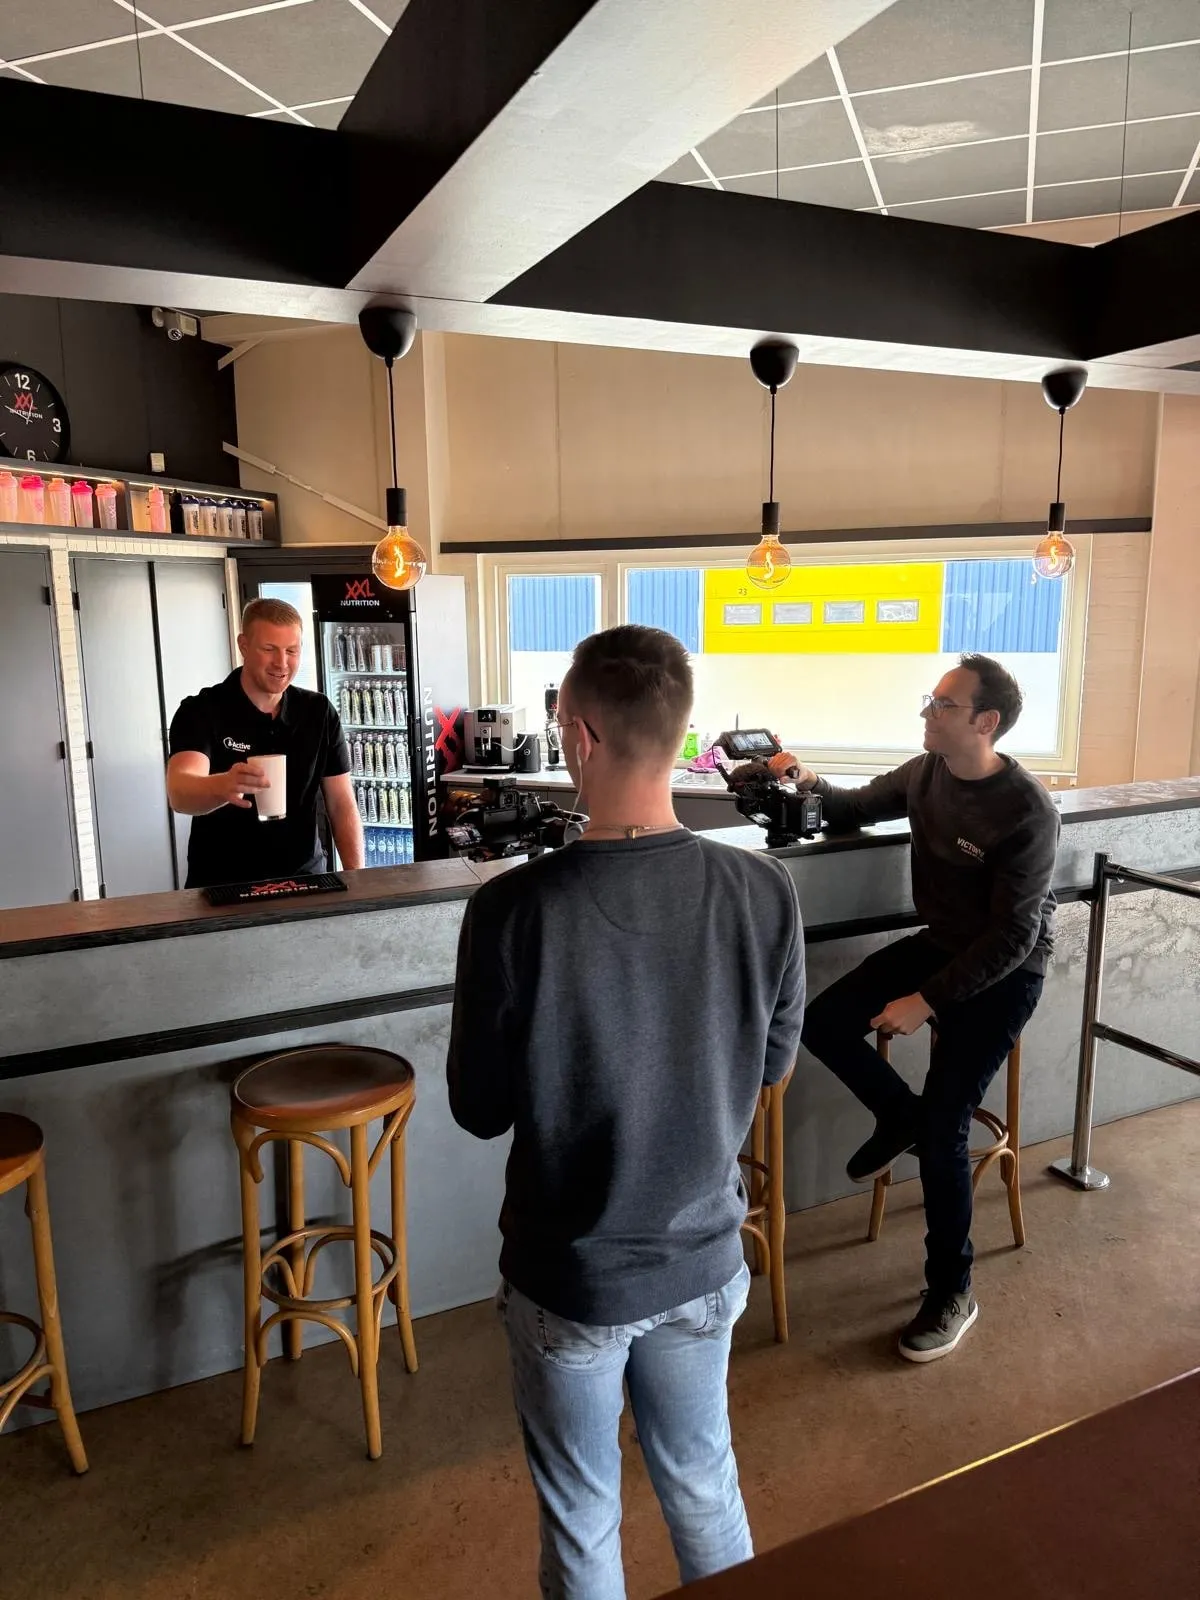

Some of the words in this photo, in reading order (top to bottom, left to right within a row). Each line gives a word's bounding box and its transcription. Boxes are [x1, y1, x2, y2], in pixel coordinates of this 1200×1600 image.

[14, 373, 31, 390] 12
[9, 408, 43, 419] TRIION
[52, 418, 61, 433] 3
[26, 449, 36, 461] 6
[345, 578, 375, 600] XXL
[738, 587, 747, 596] 23
[423, 687, 438, 837] NUTRITION
